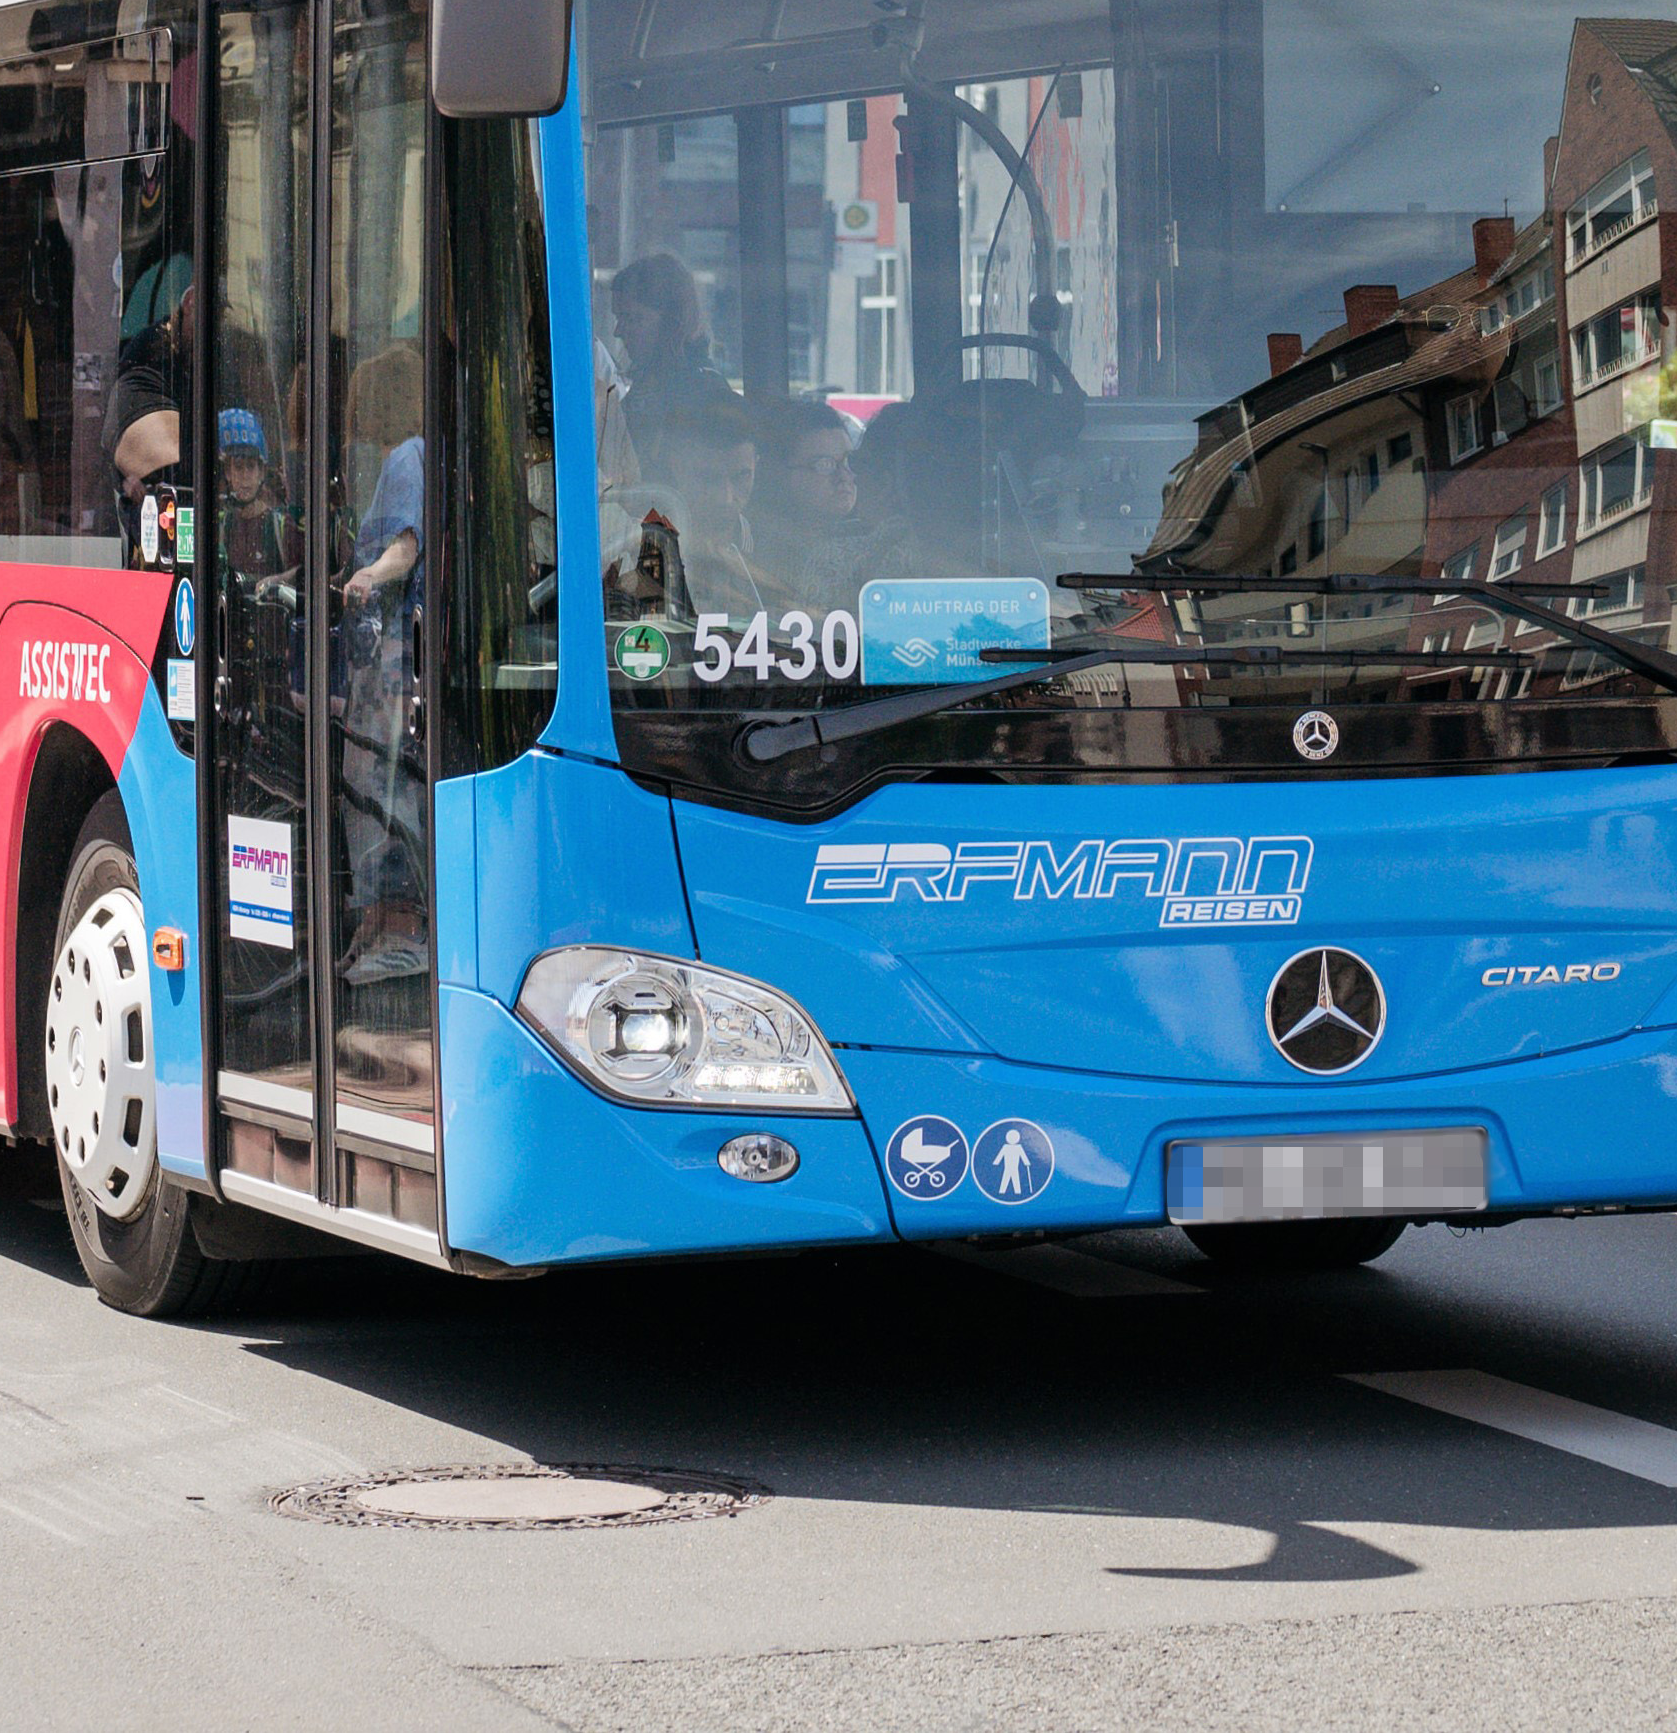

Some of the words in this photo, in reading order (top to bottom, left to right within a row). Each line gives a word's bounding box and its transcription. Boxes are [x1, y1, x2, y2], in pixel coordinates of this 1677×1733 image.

[888, 601, 906, 615] IM
[911, 600, 986, 615] AUFTRAG
[989, 599, 1021, 614] DER
[634, 627, 651, 652] 4
[692, 608, 860, 682] 5430
[945, 637, 1023, 652] Stadtwerke
[20, 640, 110, 703] ASSISTEC
[232, 844, 288, 876] ERFMANN
[806, 835, 1315, 904] ERFMANN
[1168, 900, 1295, 922] REISEN
[1481, 962, 1621, 986] CITARO
